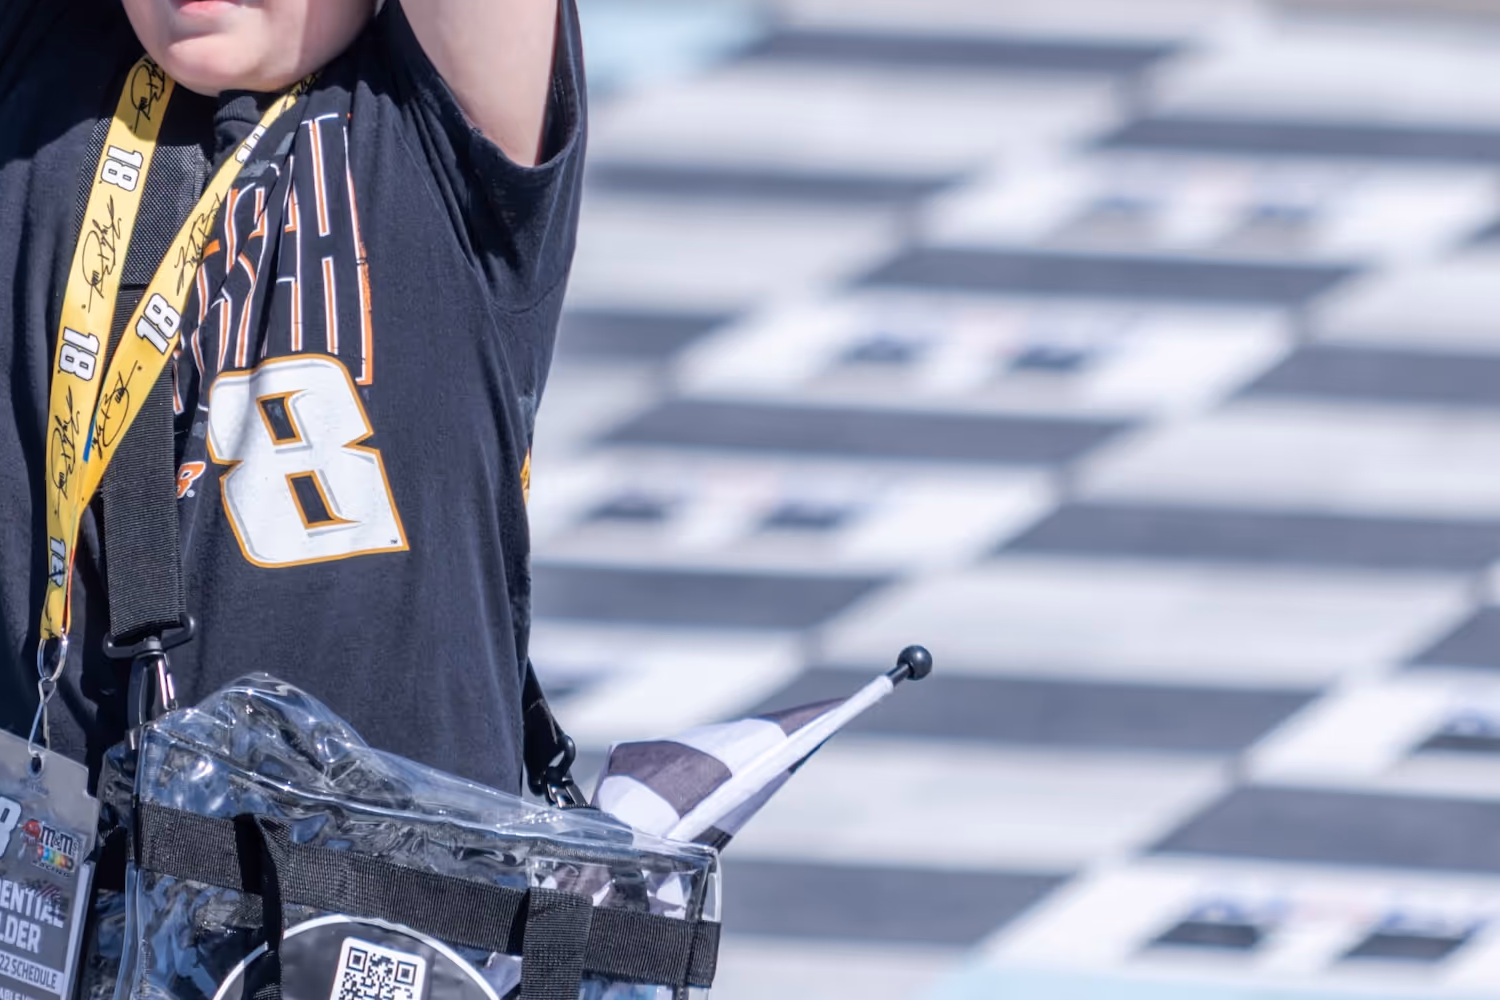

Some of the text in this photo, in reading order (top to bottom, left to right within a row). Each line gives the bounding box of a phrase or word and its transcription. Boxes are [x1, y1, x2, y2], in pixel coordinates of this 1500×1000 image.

[100, 144, 145, 193] 18
[134, 292, 182, 356] 18
[58, 326, 101, 382] 18
[206, 353, 410, 568] 8
[9, 958, 59, 990] SCHEDULE
